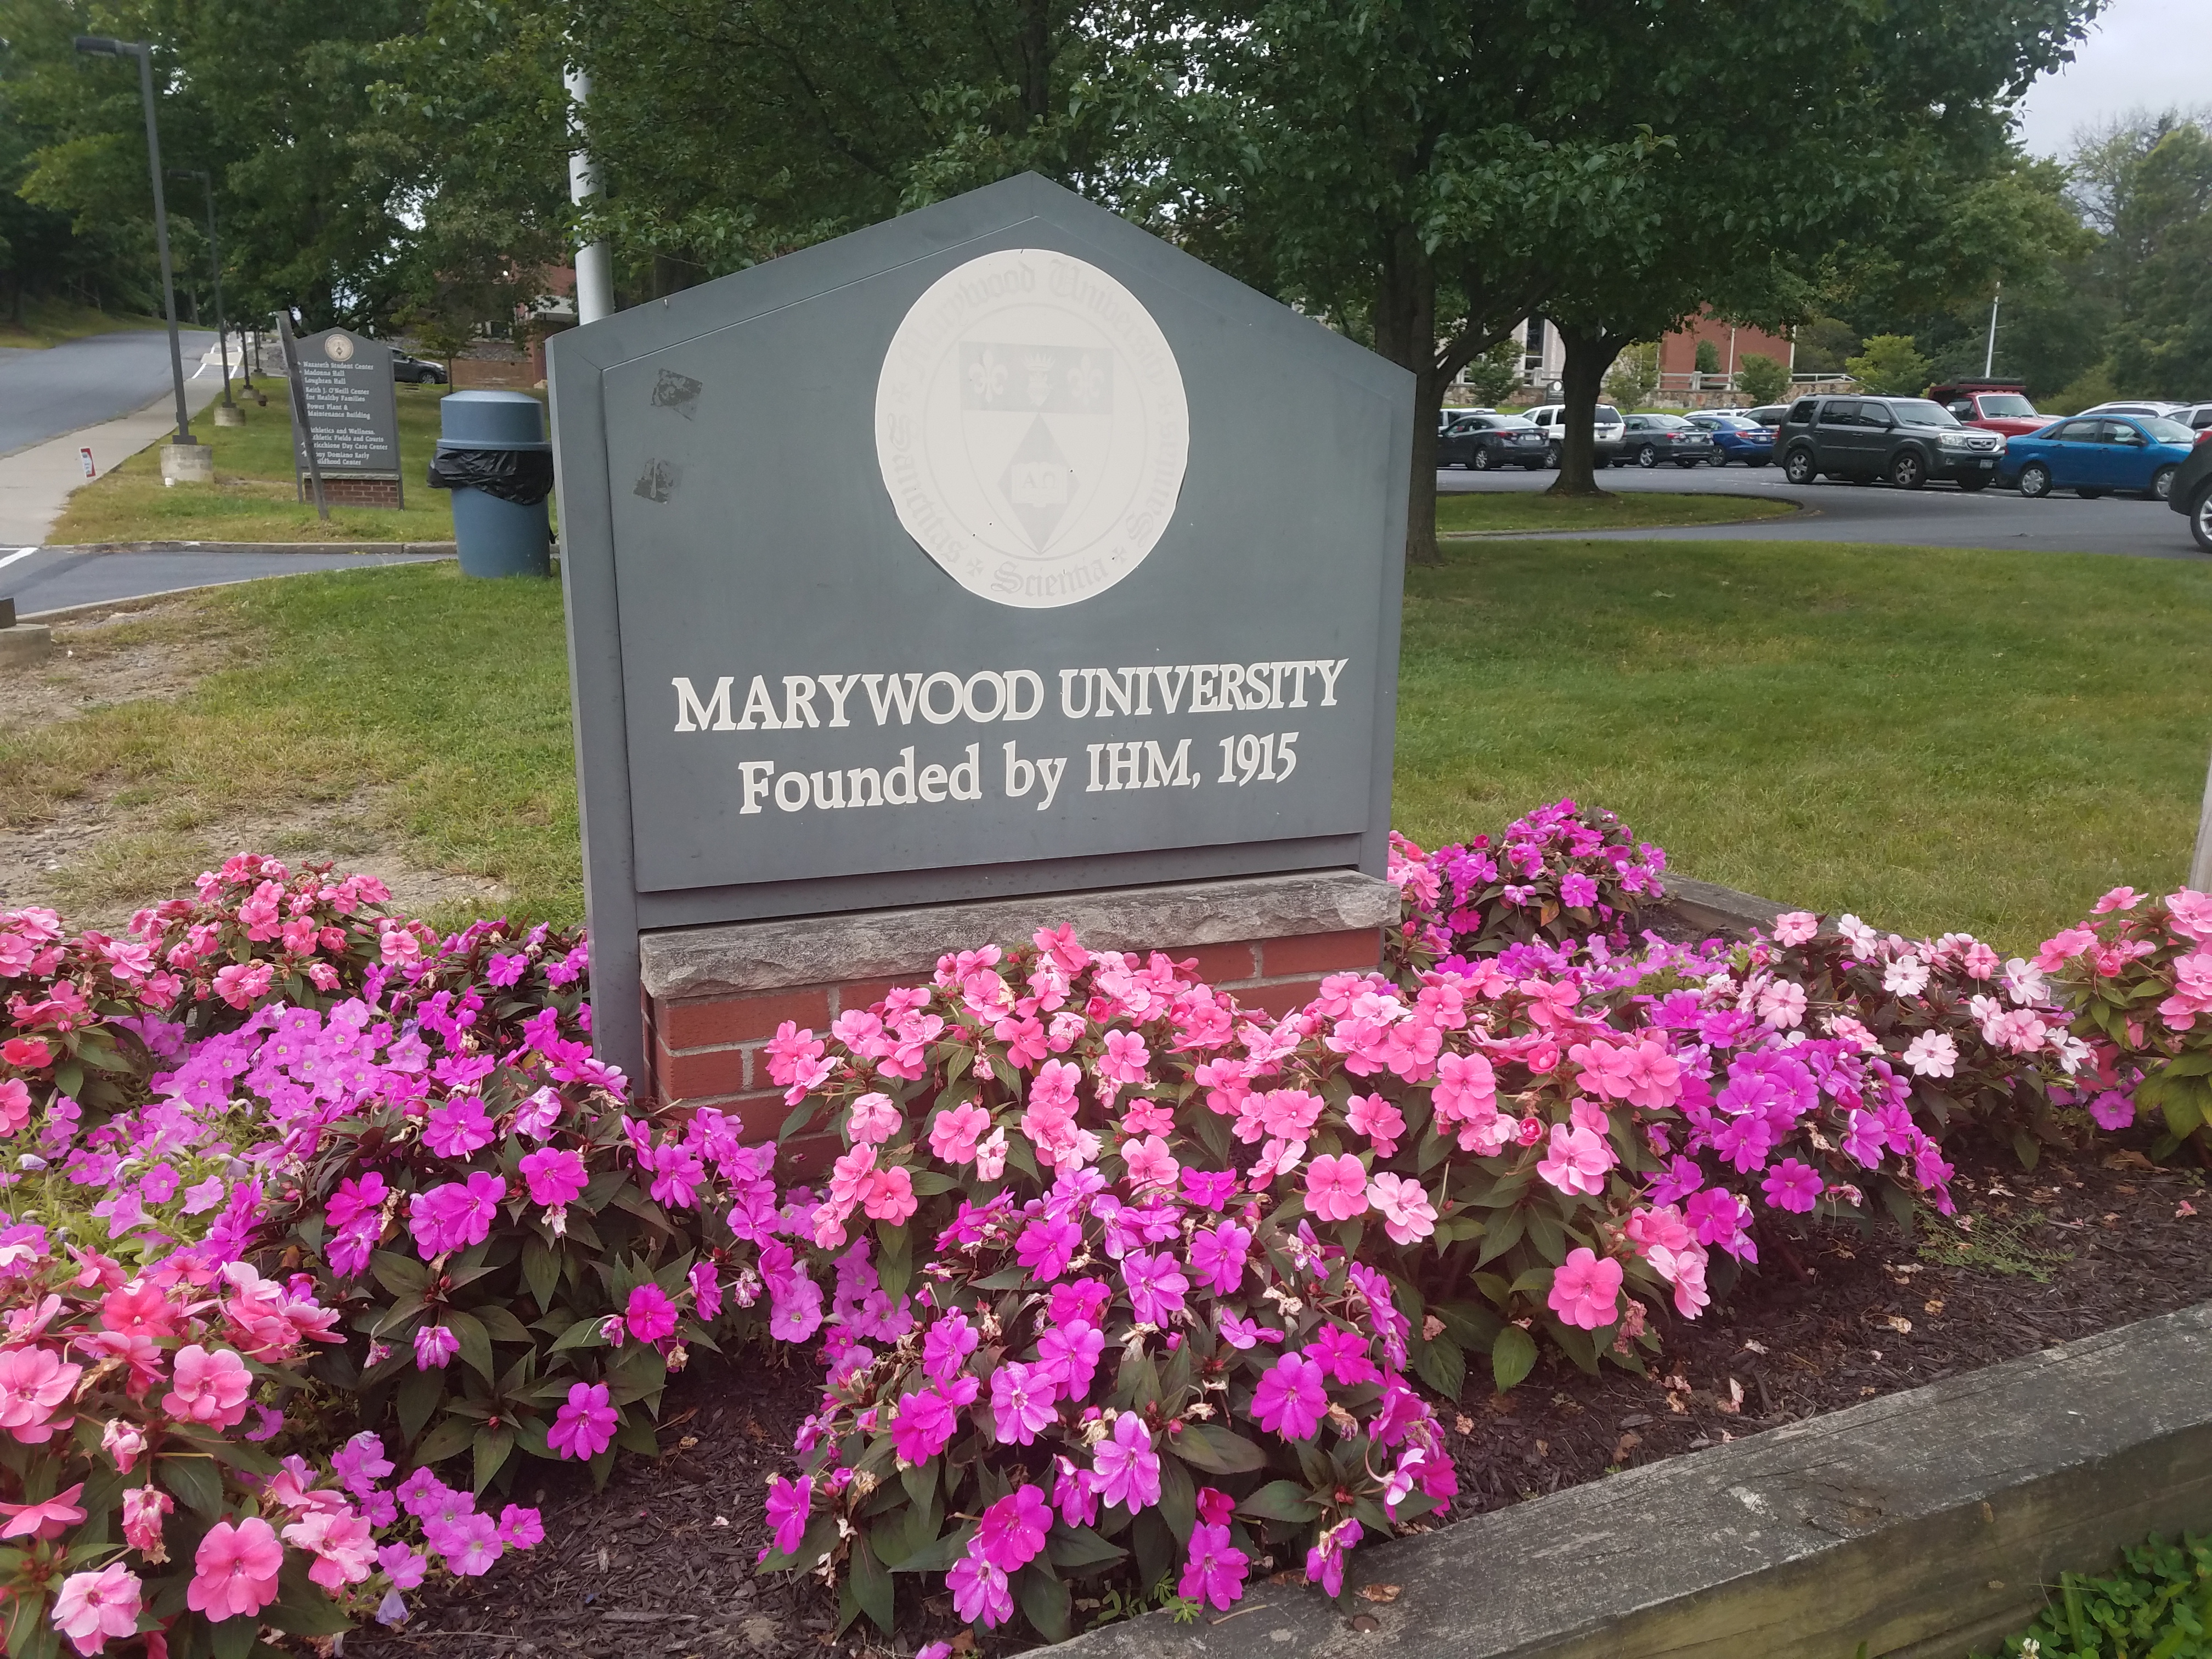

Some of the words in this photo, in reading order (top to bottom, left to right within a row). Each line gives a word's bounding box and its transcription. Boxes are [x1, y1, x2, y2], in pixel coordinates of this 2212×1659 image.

[900, 261, 1035, 383] Marywood
[1049, 259, 1167, 387] University
[346, 411, 370, 420] Building
[354, 452, 369, 460] Early
[888, 413, 967, 563] Sanctitas
[991, 558, 1109, 597] Scientia
[671, 669, 1045, 732] MARYWOOD
[1058, 658, 1350, 719] UNIVERSITY
[738, 742, 983, 815] Founded
[1002, 740, 1068, 811] by
[1085, 738, 1201, 792] IHM,
[1217, 731, 1300, 787] 1915
